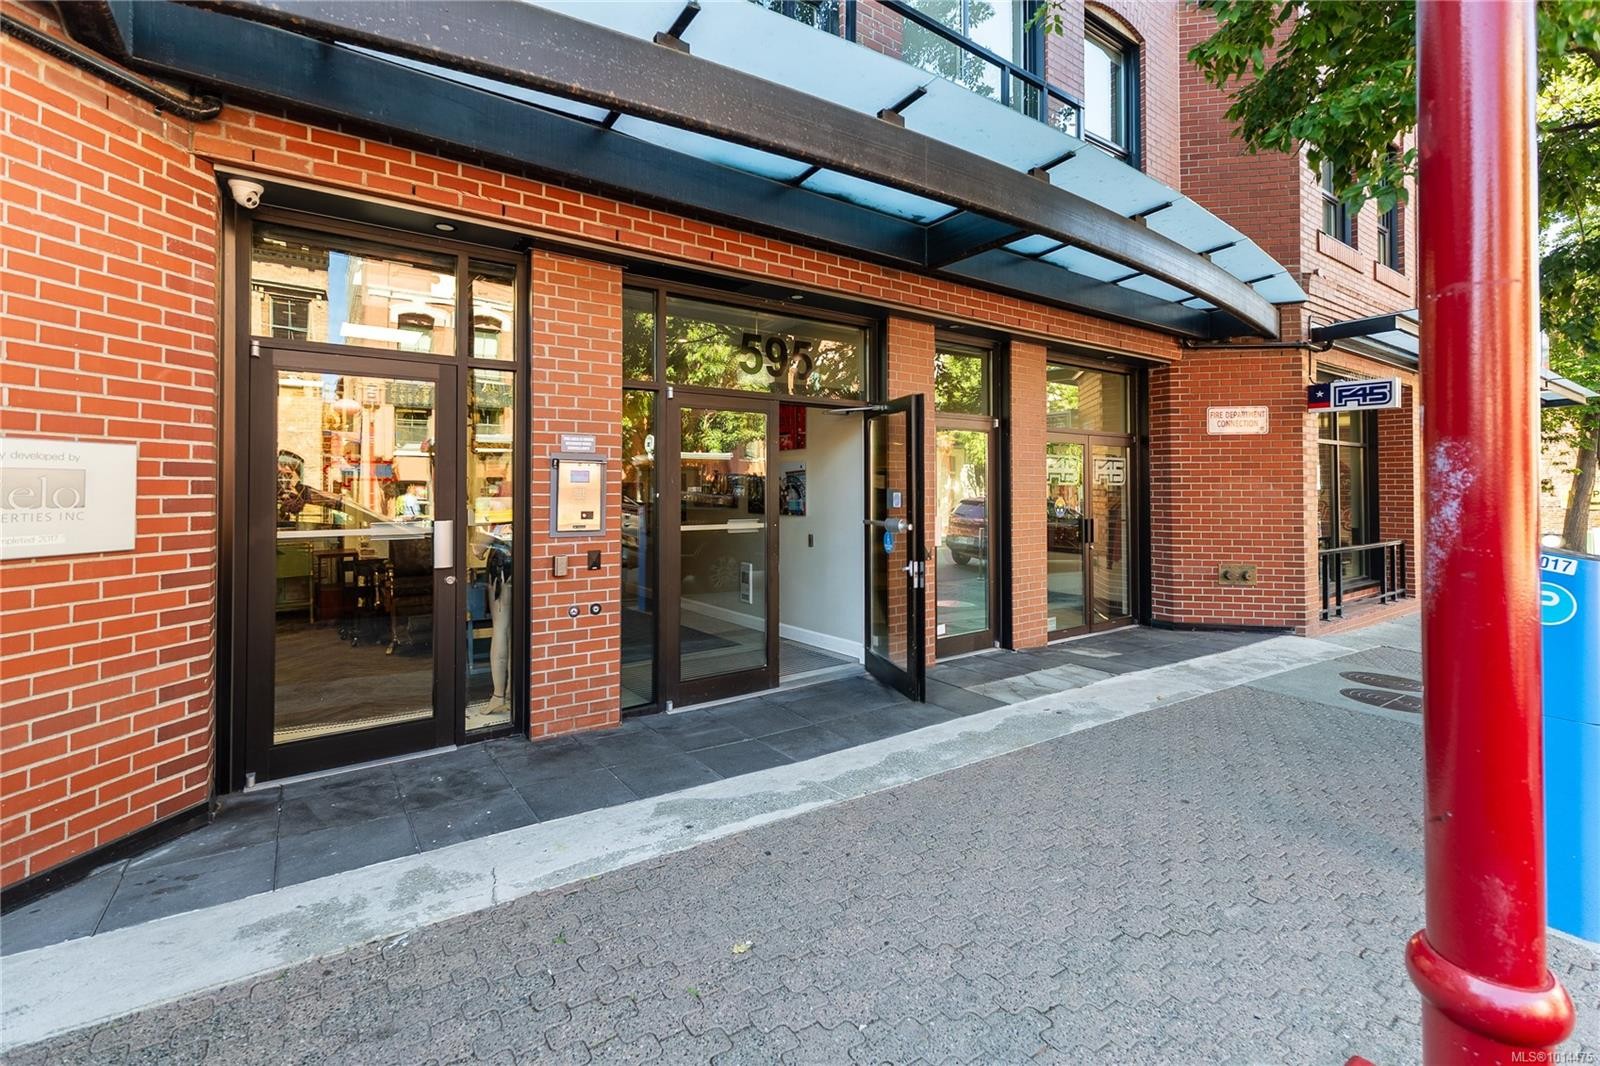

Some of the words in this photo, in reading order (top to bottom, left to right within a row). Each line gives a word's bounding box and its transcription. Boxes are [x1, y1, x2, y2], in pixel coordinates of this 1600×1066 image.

[738, 332, 813, 380] 595
[1334, 381, 1392, 407] F45
[1210, 411, 1224, 419] FIRE
[1225, 410, 1265, 419] DEPARTMENT
[10, 450, 65, 462] developed
[68, 451, 81, 463] by
[1093, 457, 1126, 485] F45
[0, 474, 80, 509] elo
[59, 511, 85, 521] INC
